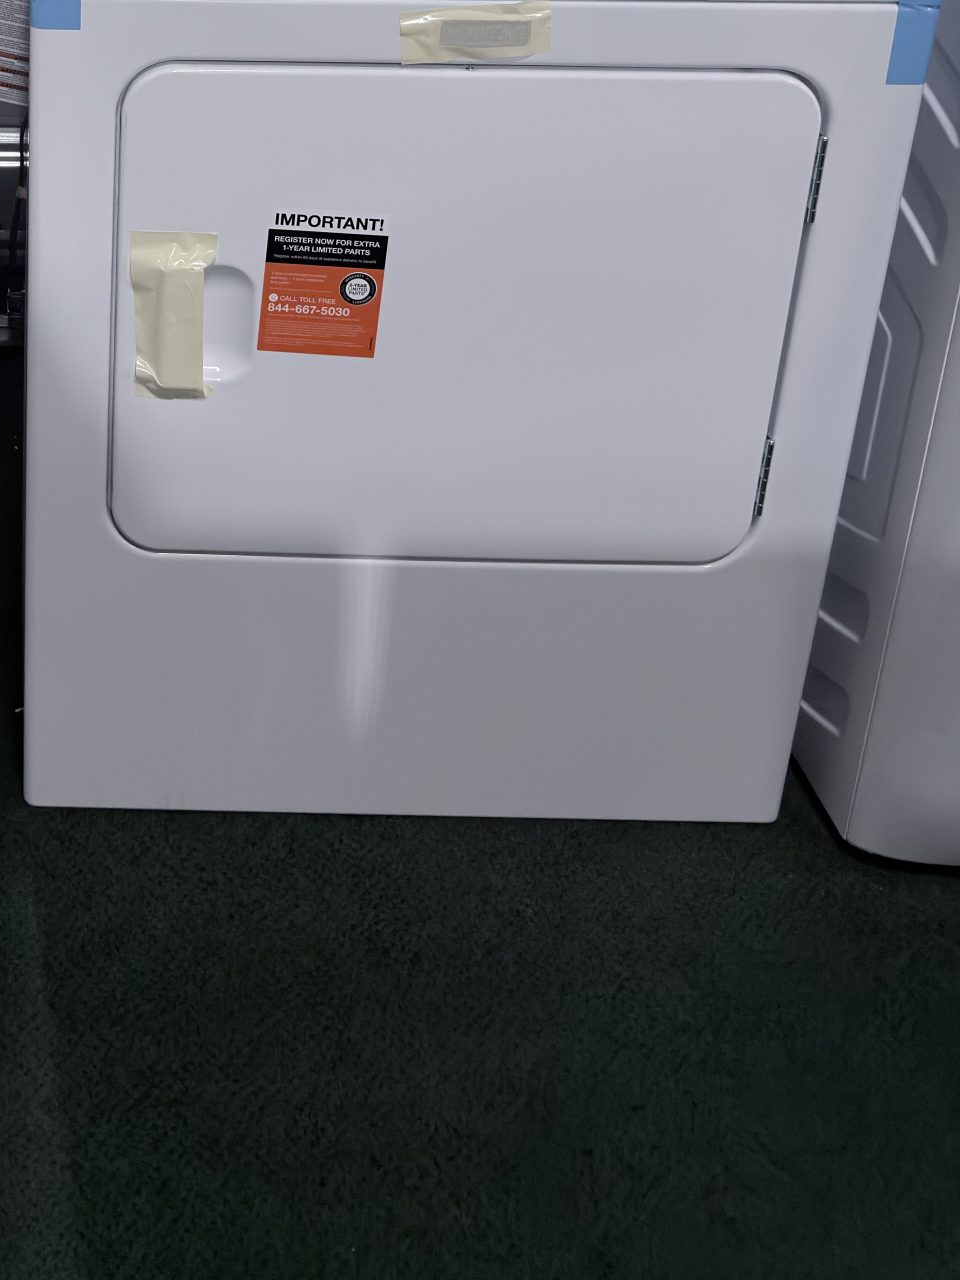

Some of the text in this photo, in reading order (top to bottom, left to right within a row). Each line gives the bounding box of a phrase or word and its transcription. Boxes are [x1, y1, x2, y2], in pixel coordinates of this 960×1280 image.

[274, 212, 385, 232] IMPORTANT!
[274, 235, 381, 248] REGISTER NOW FOR EXTRA
[282, 244, 371, 256] 1-YEAR LIMITED PARTS
[318, 297, 336, 305] FREE
[267, 302, 350, 317] 844-667-5030
